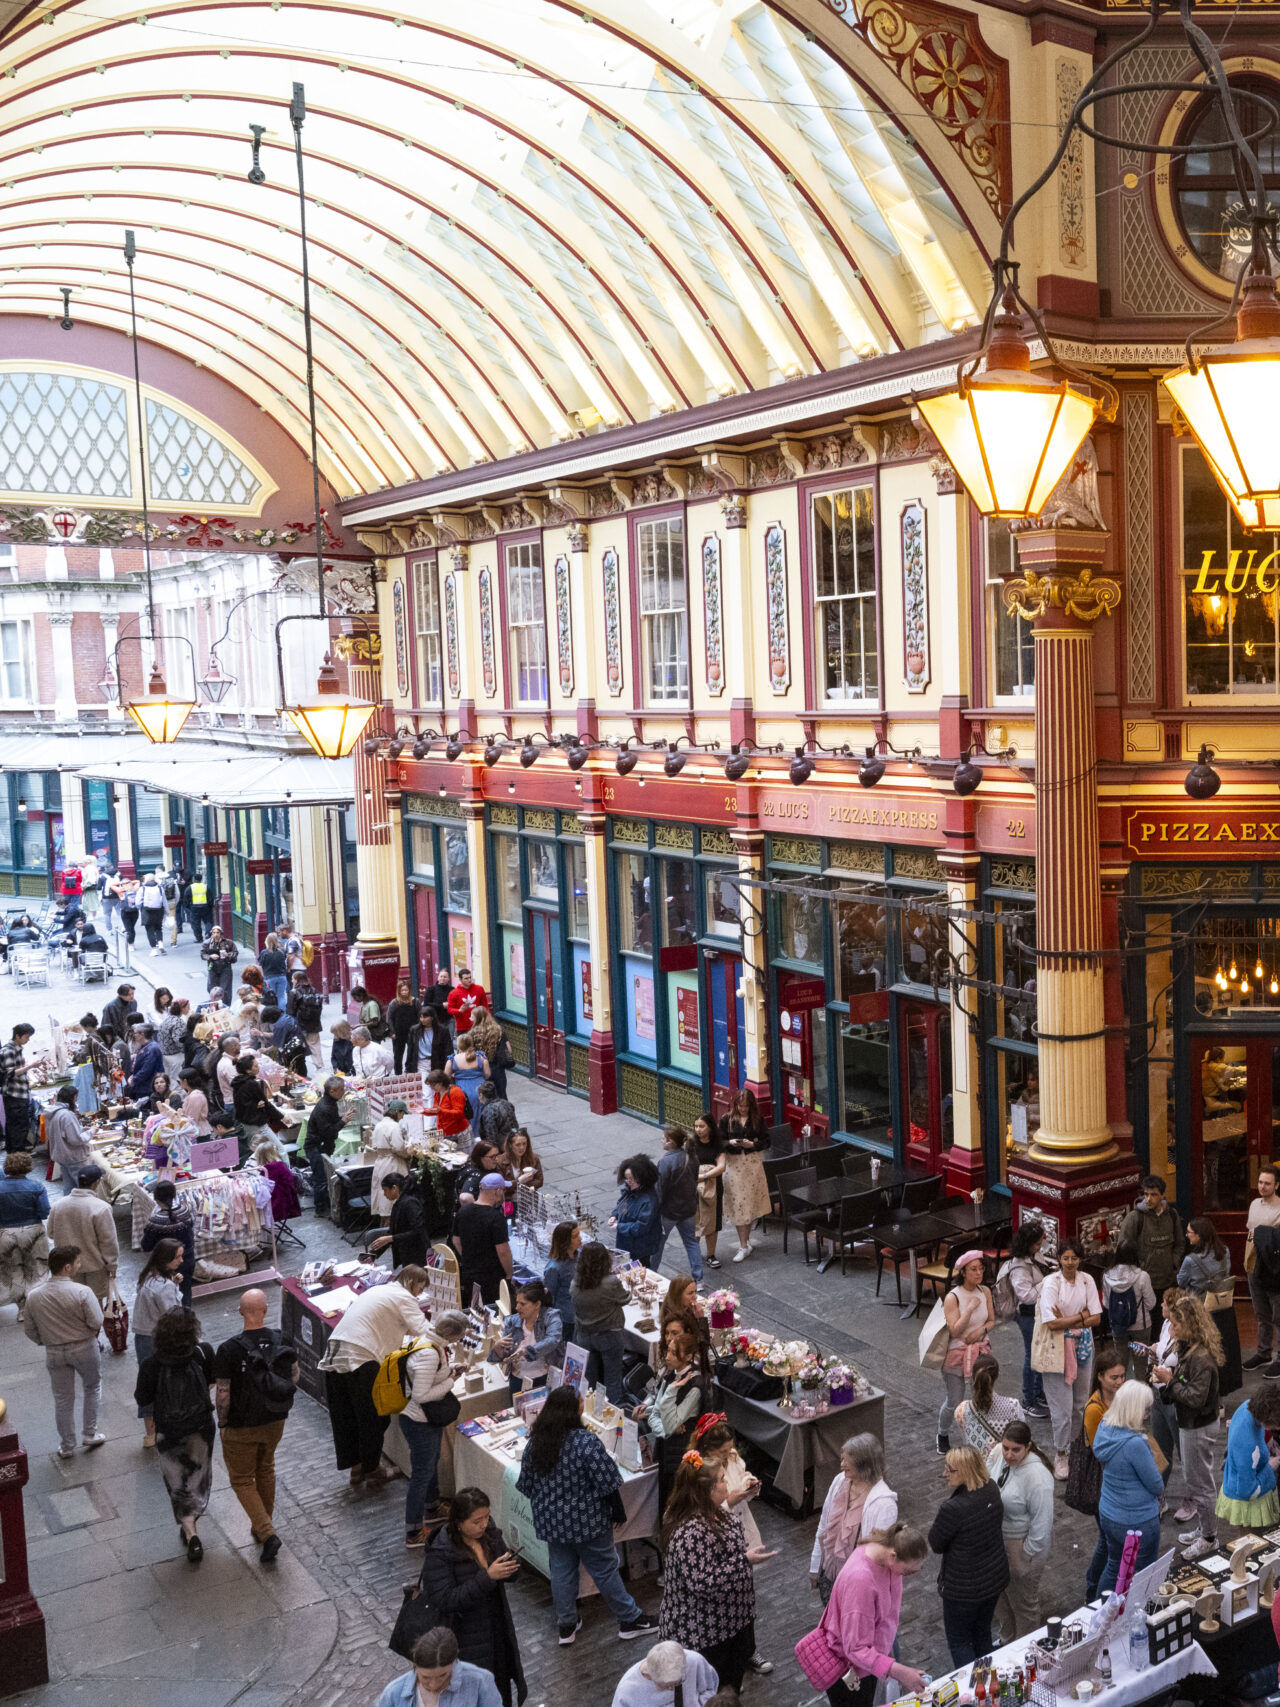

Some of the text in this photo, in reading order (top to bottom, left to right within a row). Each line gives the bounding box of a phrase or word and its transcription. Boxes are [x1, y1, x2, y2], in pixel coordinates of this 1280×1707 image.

[605, 787, 738, 812] 23 23
[763, 801, 809, 819] 22 LUC'S
[828, 805, 939, 830] PIZZAEXPRESS
[1008, 819, 1026, 838] 22
